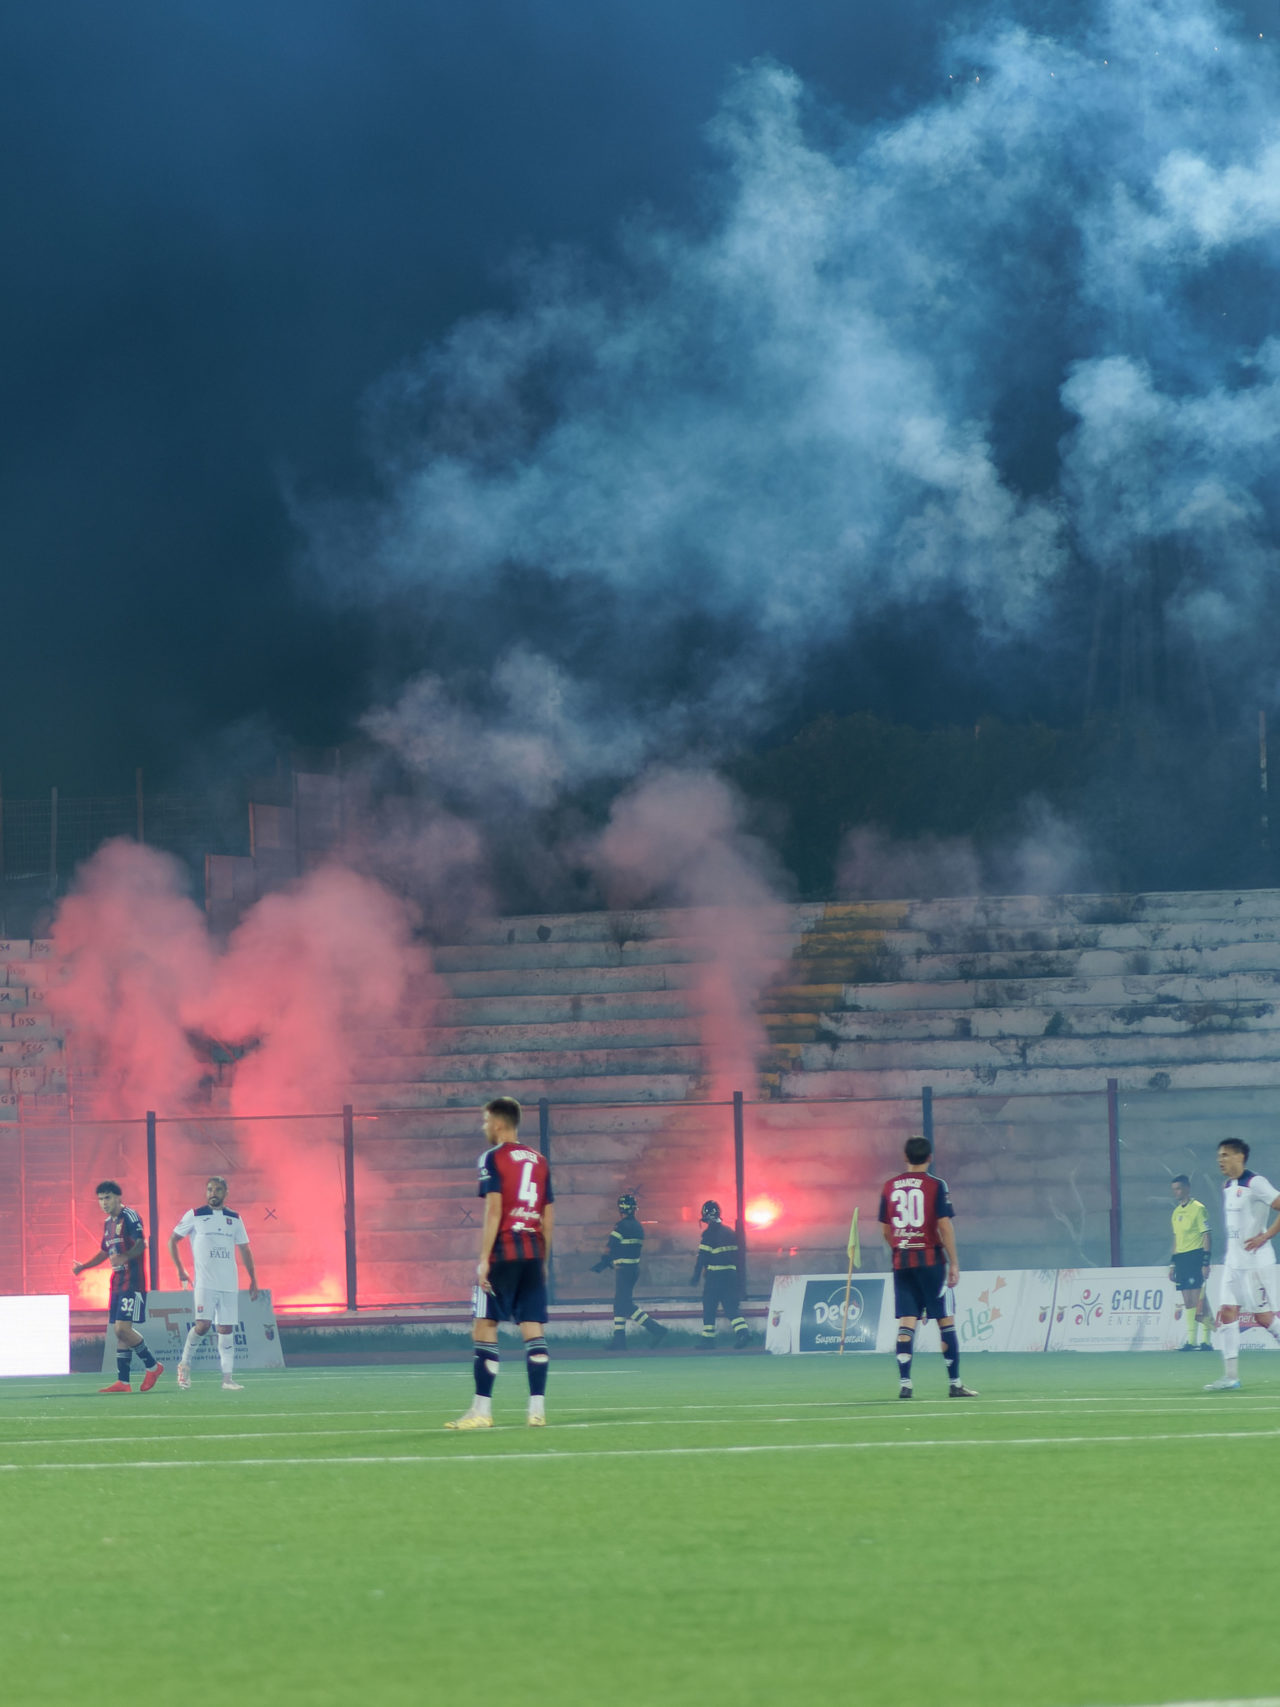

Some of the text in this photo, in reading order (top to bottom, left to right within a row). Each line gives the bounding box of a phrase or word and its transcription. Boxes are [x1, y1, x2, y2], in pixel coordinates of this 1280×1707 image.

[518, 1162, 538, 1208] 4
[891, 1188, 925, 1228] 30
[120, 1298, 134, 1312] 32
[1111, 1288, 1164, 1312] GALEO
[1107, 1315, 1161, 1327] ENERGY
